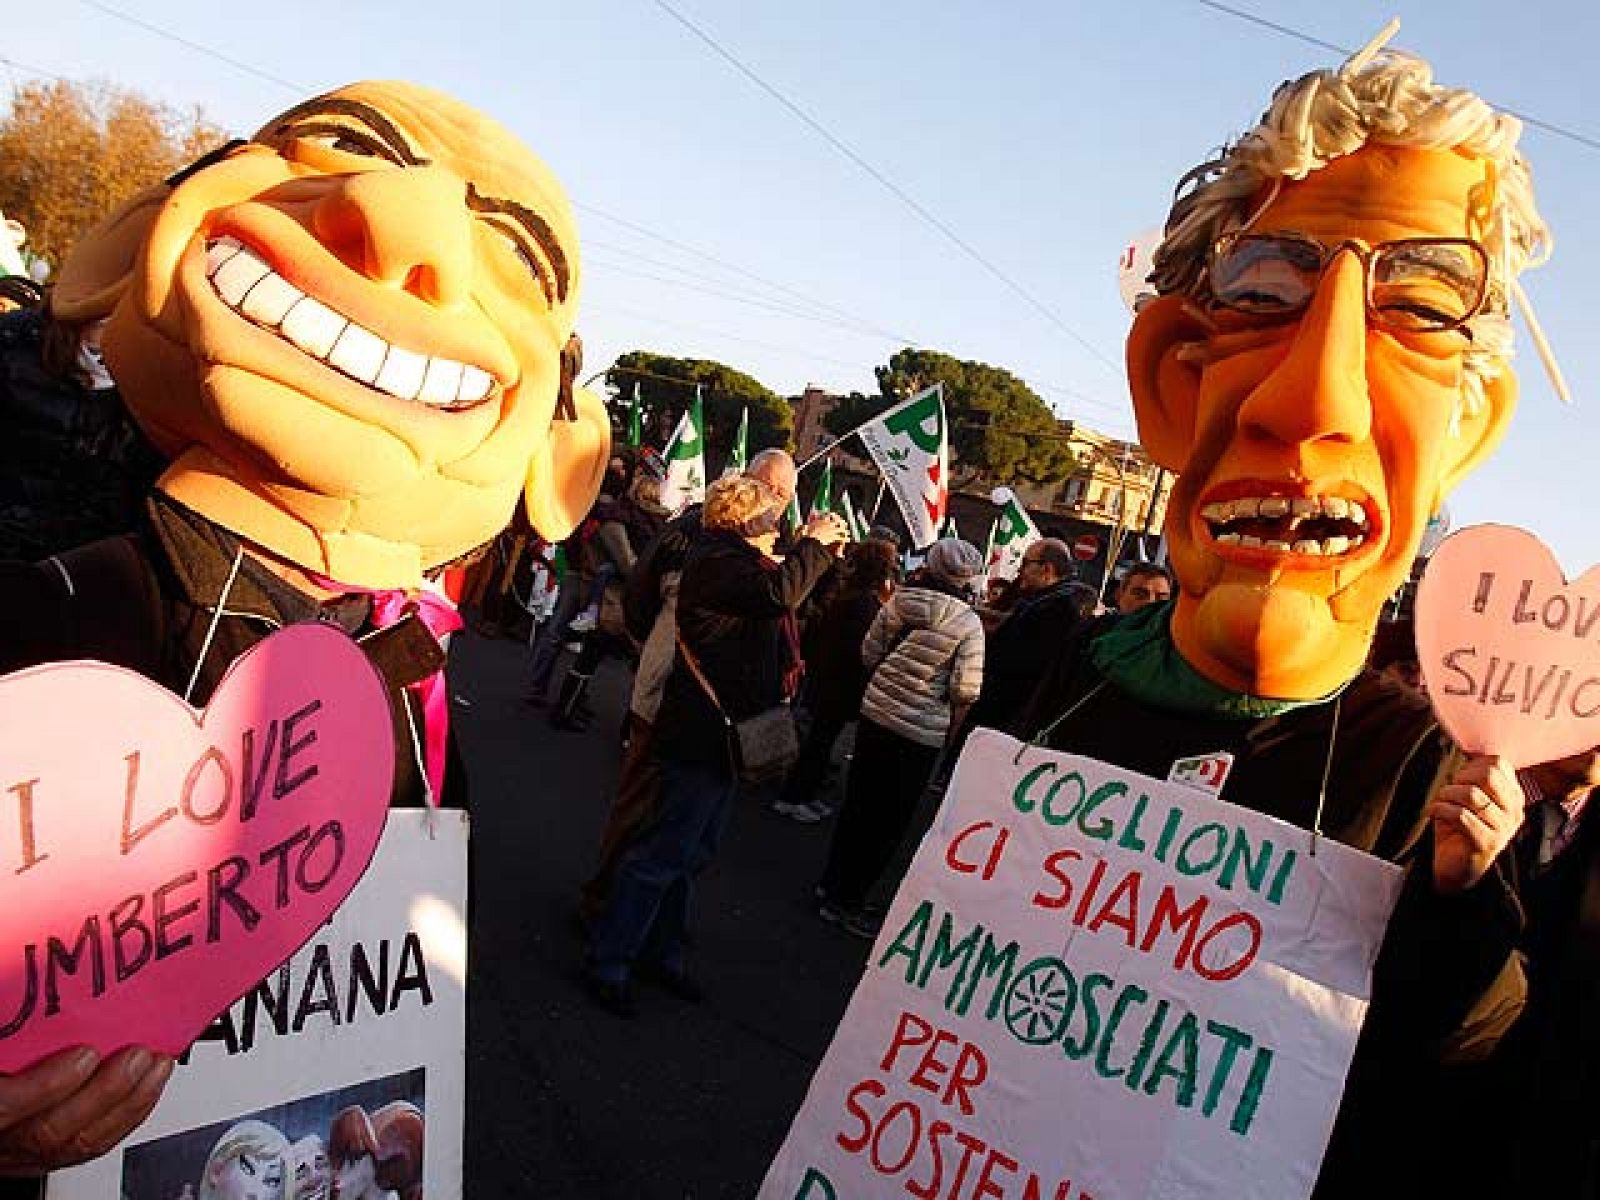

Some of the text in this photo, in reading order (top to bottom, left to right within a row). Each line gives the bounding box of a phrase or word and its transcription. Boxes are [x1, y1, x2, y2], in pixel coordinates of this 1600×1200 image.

[1472, 572, 1600, 643] I LOV
[1441, 646, 1600, 720] SILVIO
[6, 699, 322, 876] I LOVE
[1012, 761, 1297, 905] COGLIONI
[946, 821, 1262, 981] CI SIAMO
[878, 899, 1275, 1136] AMMOSCIATI
[879, 1012, 988, 1116] PER
